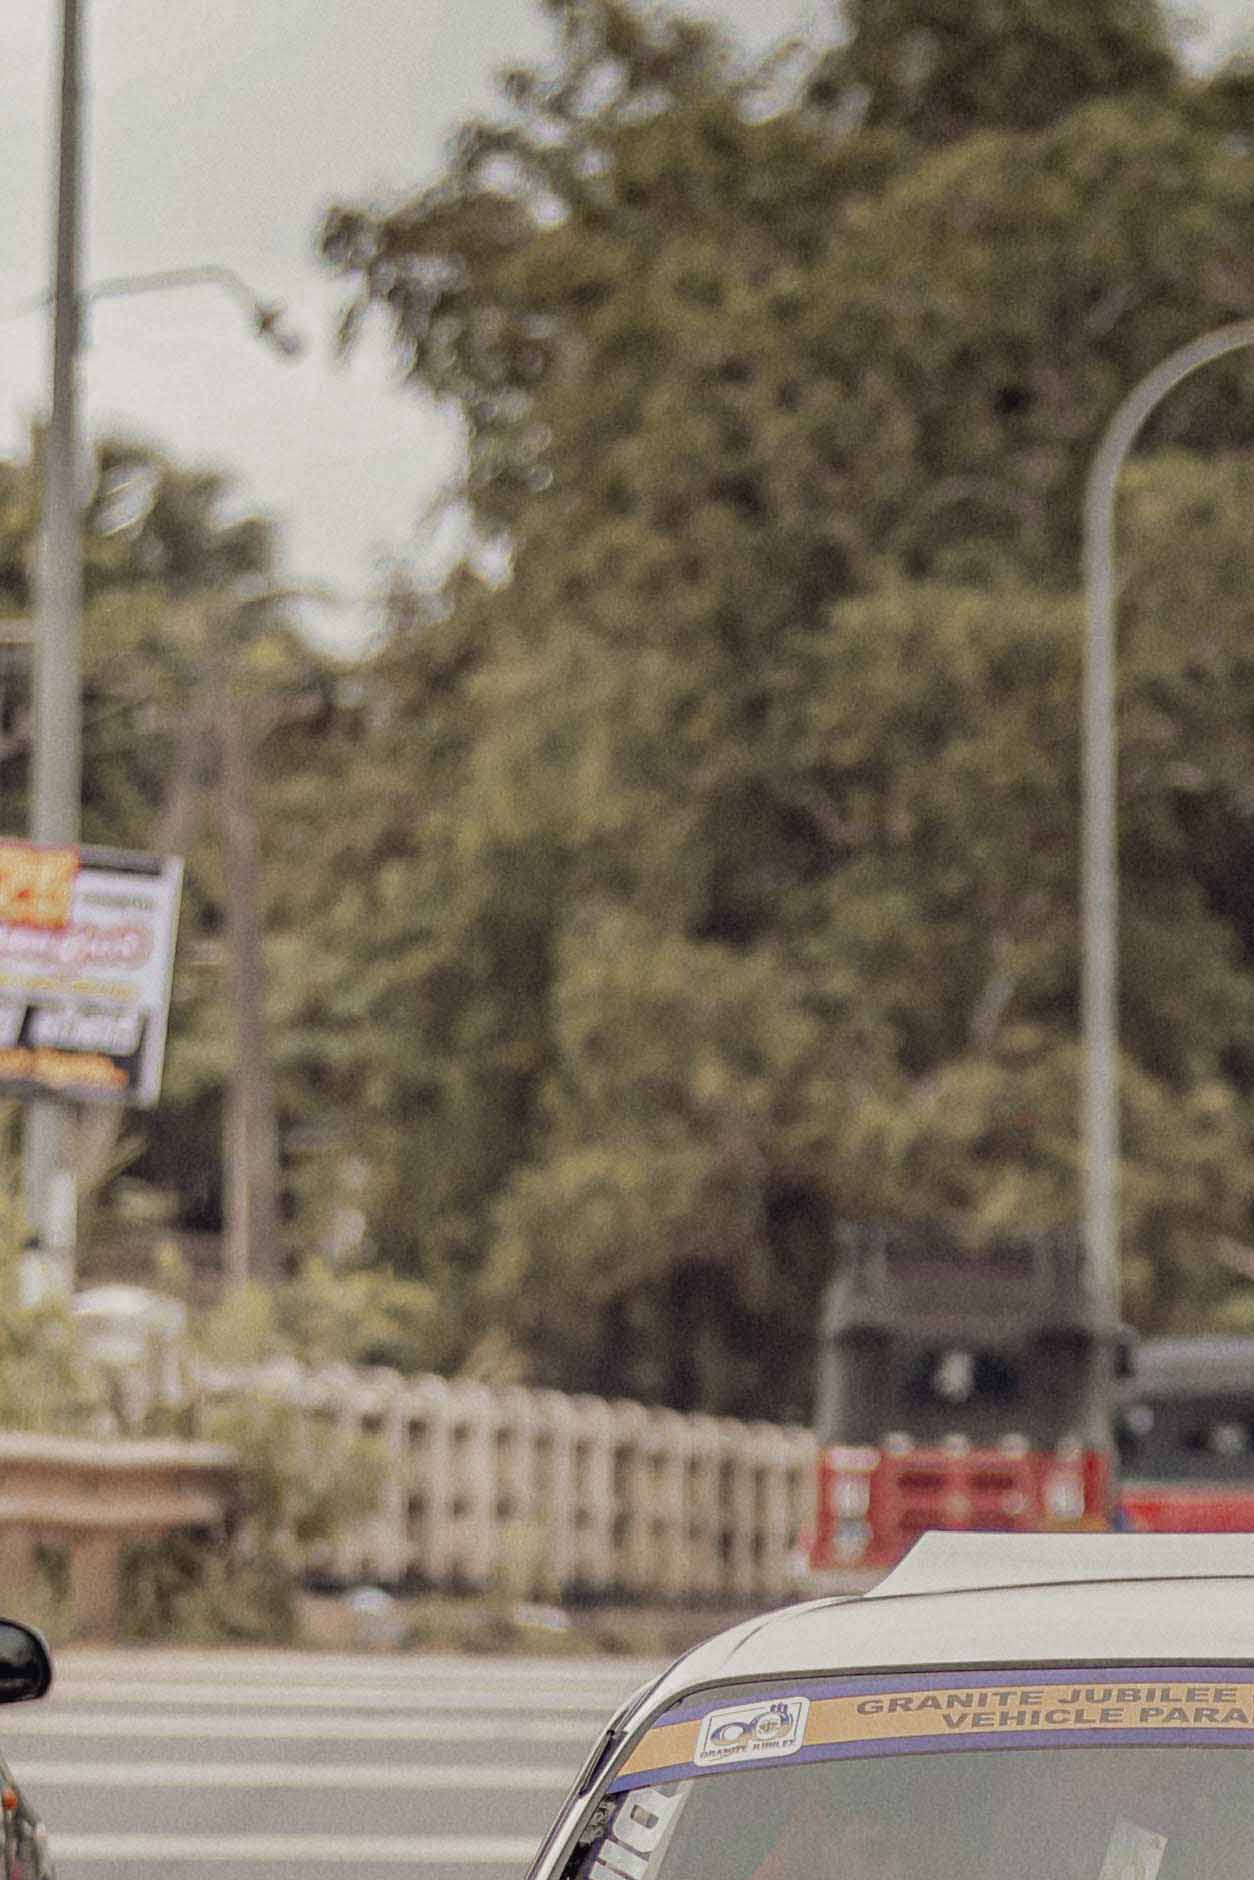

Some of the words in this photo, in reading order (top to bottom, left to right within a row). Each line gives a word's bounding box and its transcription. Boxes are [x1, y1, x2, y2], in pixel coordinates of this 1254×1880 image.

[857, 1690, 1044, 1714] GRANITE
[1058, 1687, 1237, 1705] JUBILEE
[942, 1708, 1124, 1729] VEHICLE
